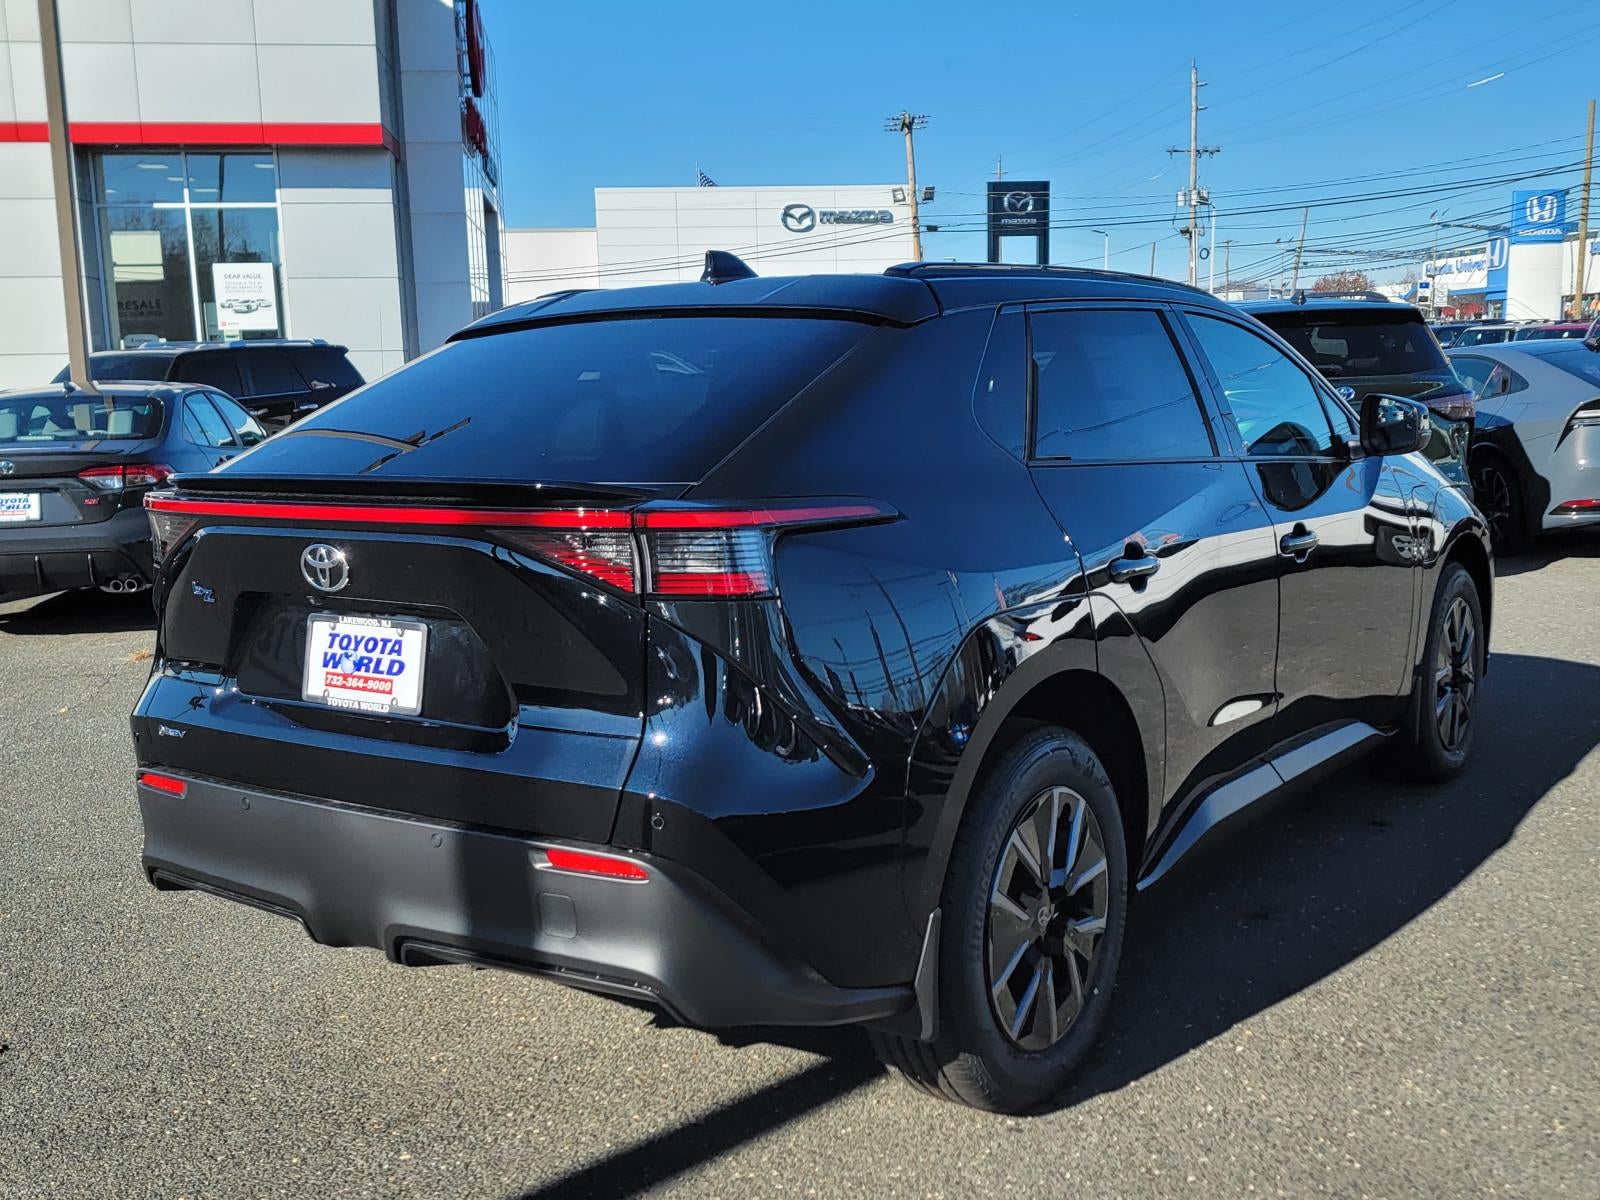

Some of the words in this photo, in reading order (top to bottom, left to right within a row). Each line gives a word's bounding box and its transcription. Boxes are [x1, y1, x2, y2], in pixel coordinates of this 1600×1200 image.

[1425, 261, 1455, 275] Hnda
[381, 619, 392, 627] NJ
[327, 632, 404, 656] TOYOTA
[321, 651, 406, 677] WORLD
[326, 674, 392, 692] 732-364-9000
[327, 697, 360, 710] TOYOTA
[359, 700, 390, 713] WORLD
